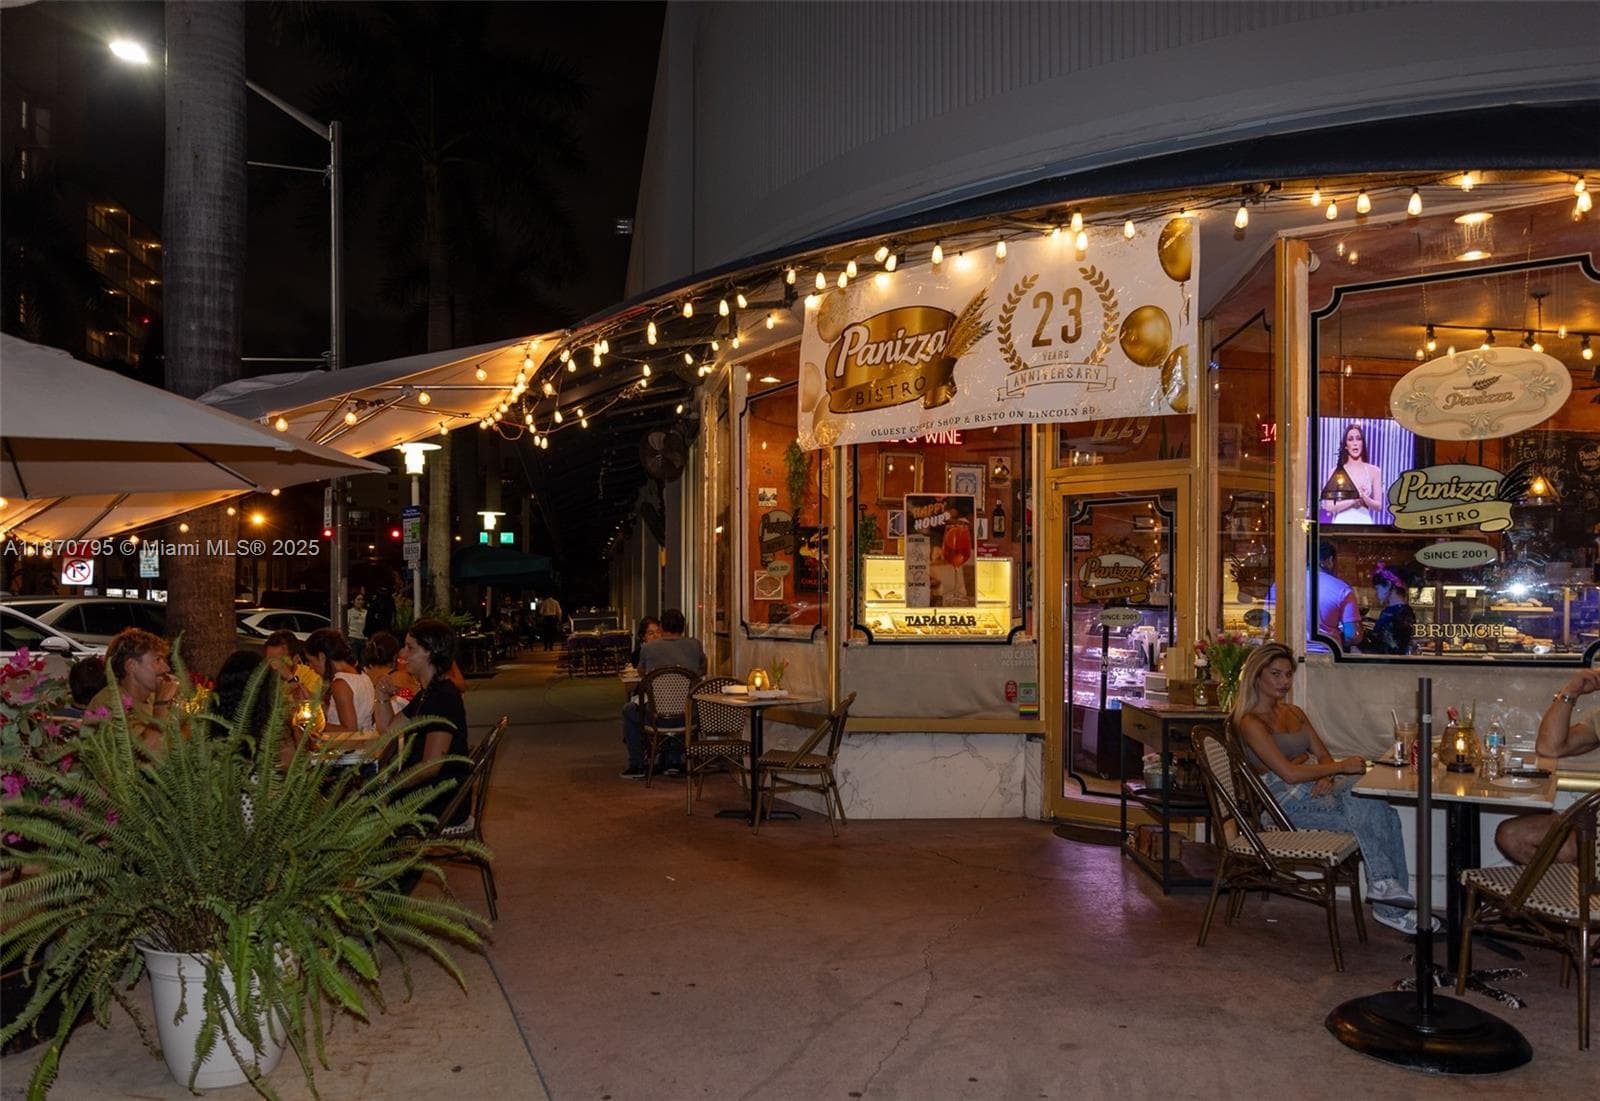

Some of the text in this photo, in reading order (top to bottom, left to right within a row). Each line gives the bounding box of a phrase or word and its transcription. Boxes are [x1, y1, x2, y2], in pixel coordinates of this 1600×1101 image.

[1031, 287, 1082, 348] 23
[834, 324, 947, 377] Panizza
[1042, 350, 1070, 360] YEARS
[1014, 366, 1101, 387] ANNIVERSARY
[855, 376, 927, 405] BISTRO
[1441, 390, 1516, 411] Panizza
[871, 427, 907, 437] OLDEST
[937, 416, 961, 427] SHOP
[974, 411, 1006, 423] RESTO
[1008, 410, 1025, 419] ON
[1028, 408, 1079, 419] LINCOLN
[1082, 406, 1096, 415] RD
[1397, 471, 1499, 505] Panizza
[1419, 508, 1480, 525] BISTRO
[1423, 549, 1488, 560] SINCE 2001
[1083, 558, 1139, 582] Panizza
[1096, 586, 1131, 597] BISTRO
[905, 615, 977, 627] TAPAS BAR
[1413, 623, 1505, 638] BRUNCH
